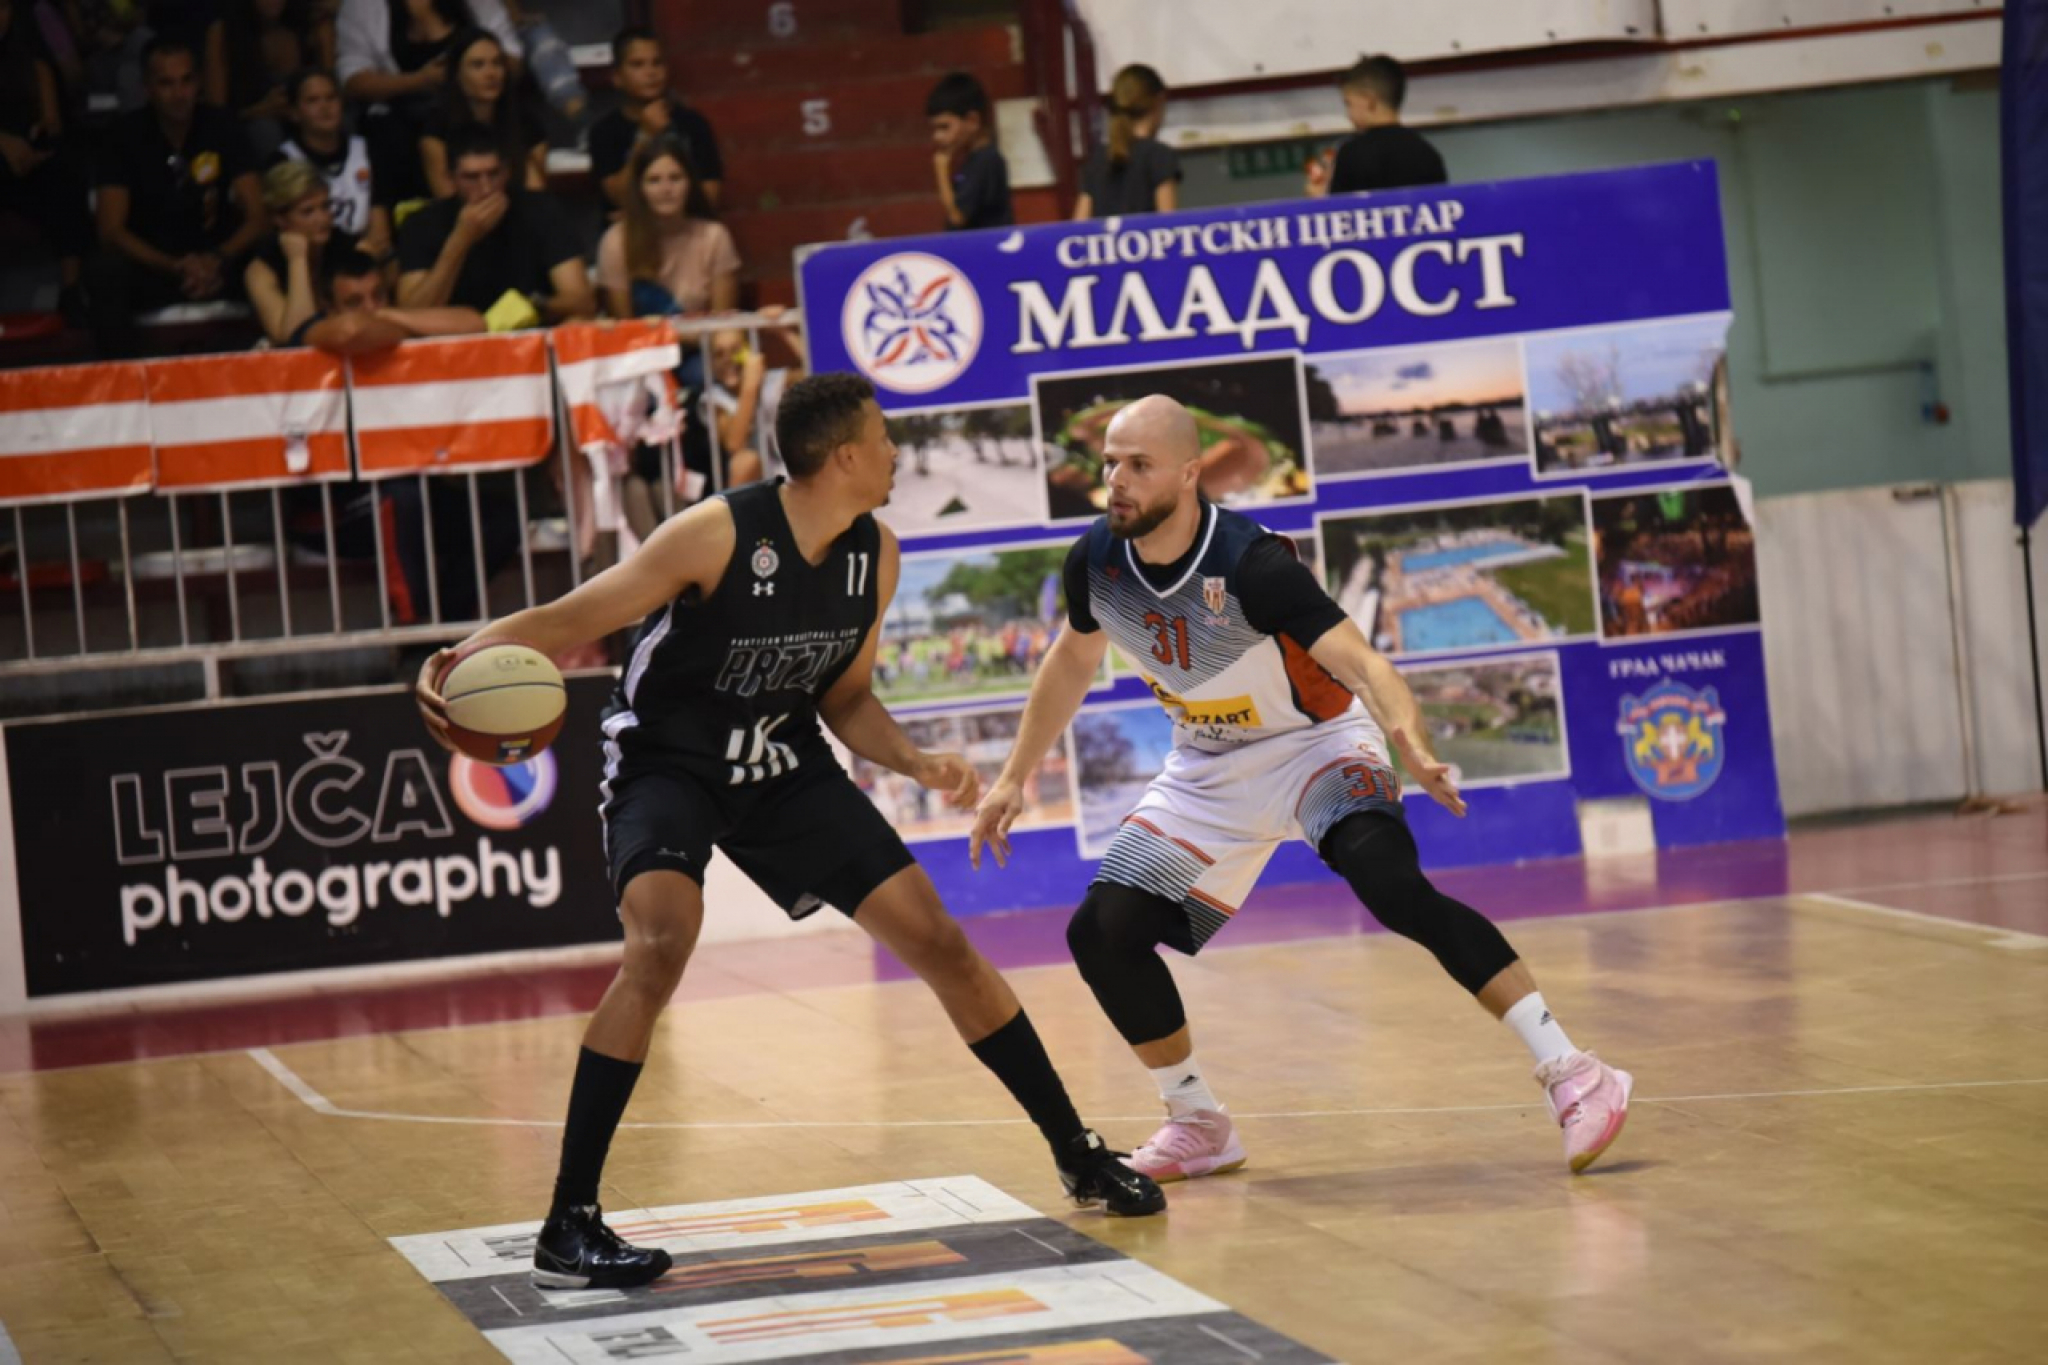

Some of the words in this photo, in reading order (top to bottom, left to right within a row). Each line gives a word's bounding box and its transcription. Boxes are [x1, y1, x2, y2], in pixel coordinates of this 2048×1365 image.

[769, 2, 795, 37] 6
[802, 99, 830, 135] 5
[1056, 216, 1290, 269] СПОРТСКИ
[1297, 199, 1465, 249] ЦЕНТАР
[1010, 232, 1525, 353] МЛАДОСТ
[847, 552, 868, 597] 11
[1144, 614, 1192, 670] 31
[110, 731, 455, 865] LEJČA
[120, 836, 563, 946] photography
